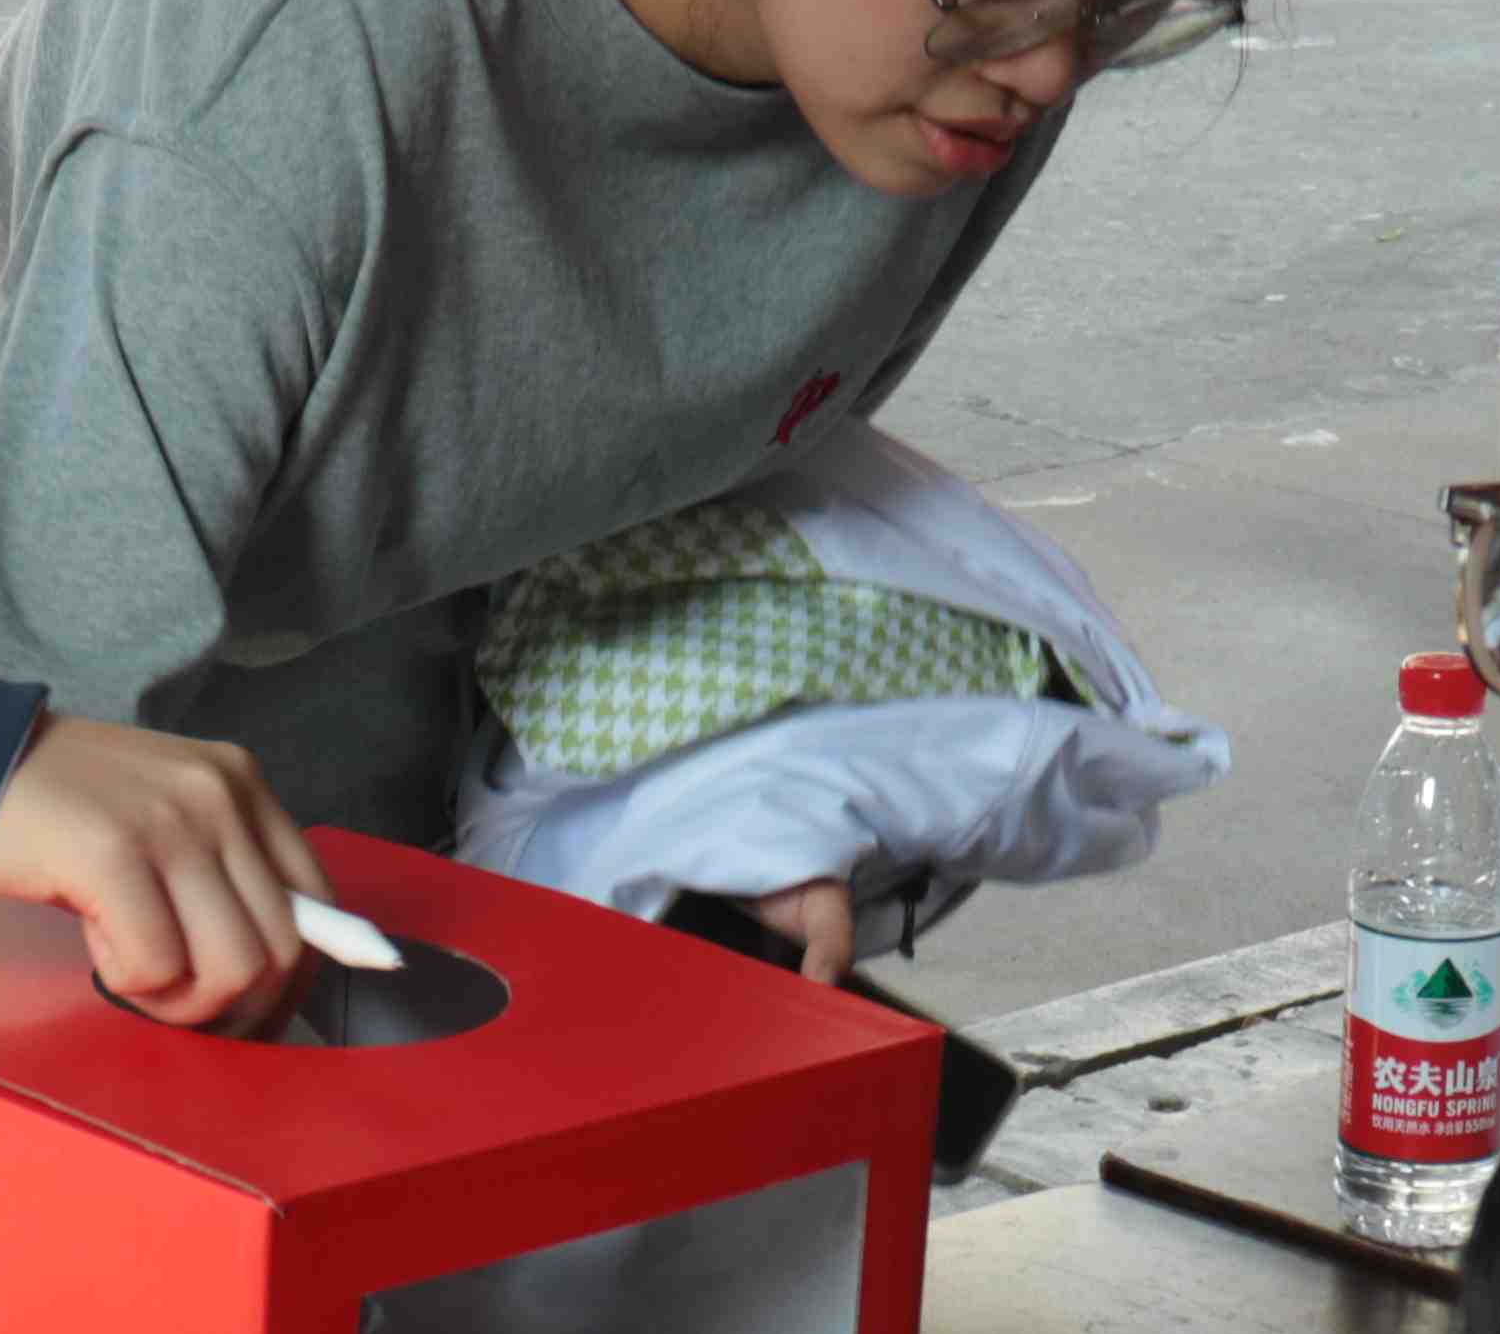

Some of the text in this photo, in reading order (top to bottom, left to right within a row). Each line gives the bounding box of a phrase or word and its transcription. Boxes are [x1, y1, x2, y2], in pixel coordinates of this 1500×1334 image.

[1372, 1055, 1498, 1097] 农夫山泉
[1371, 1092, 1440, 1118] NONGFU
